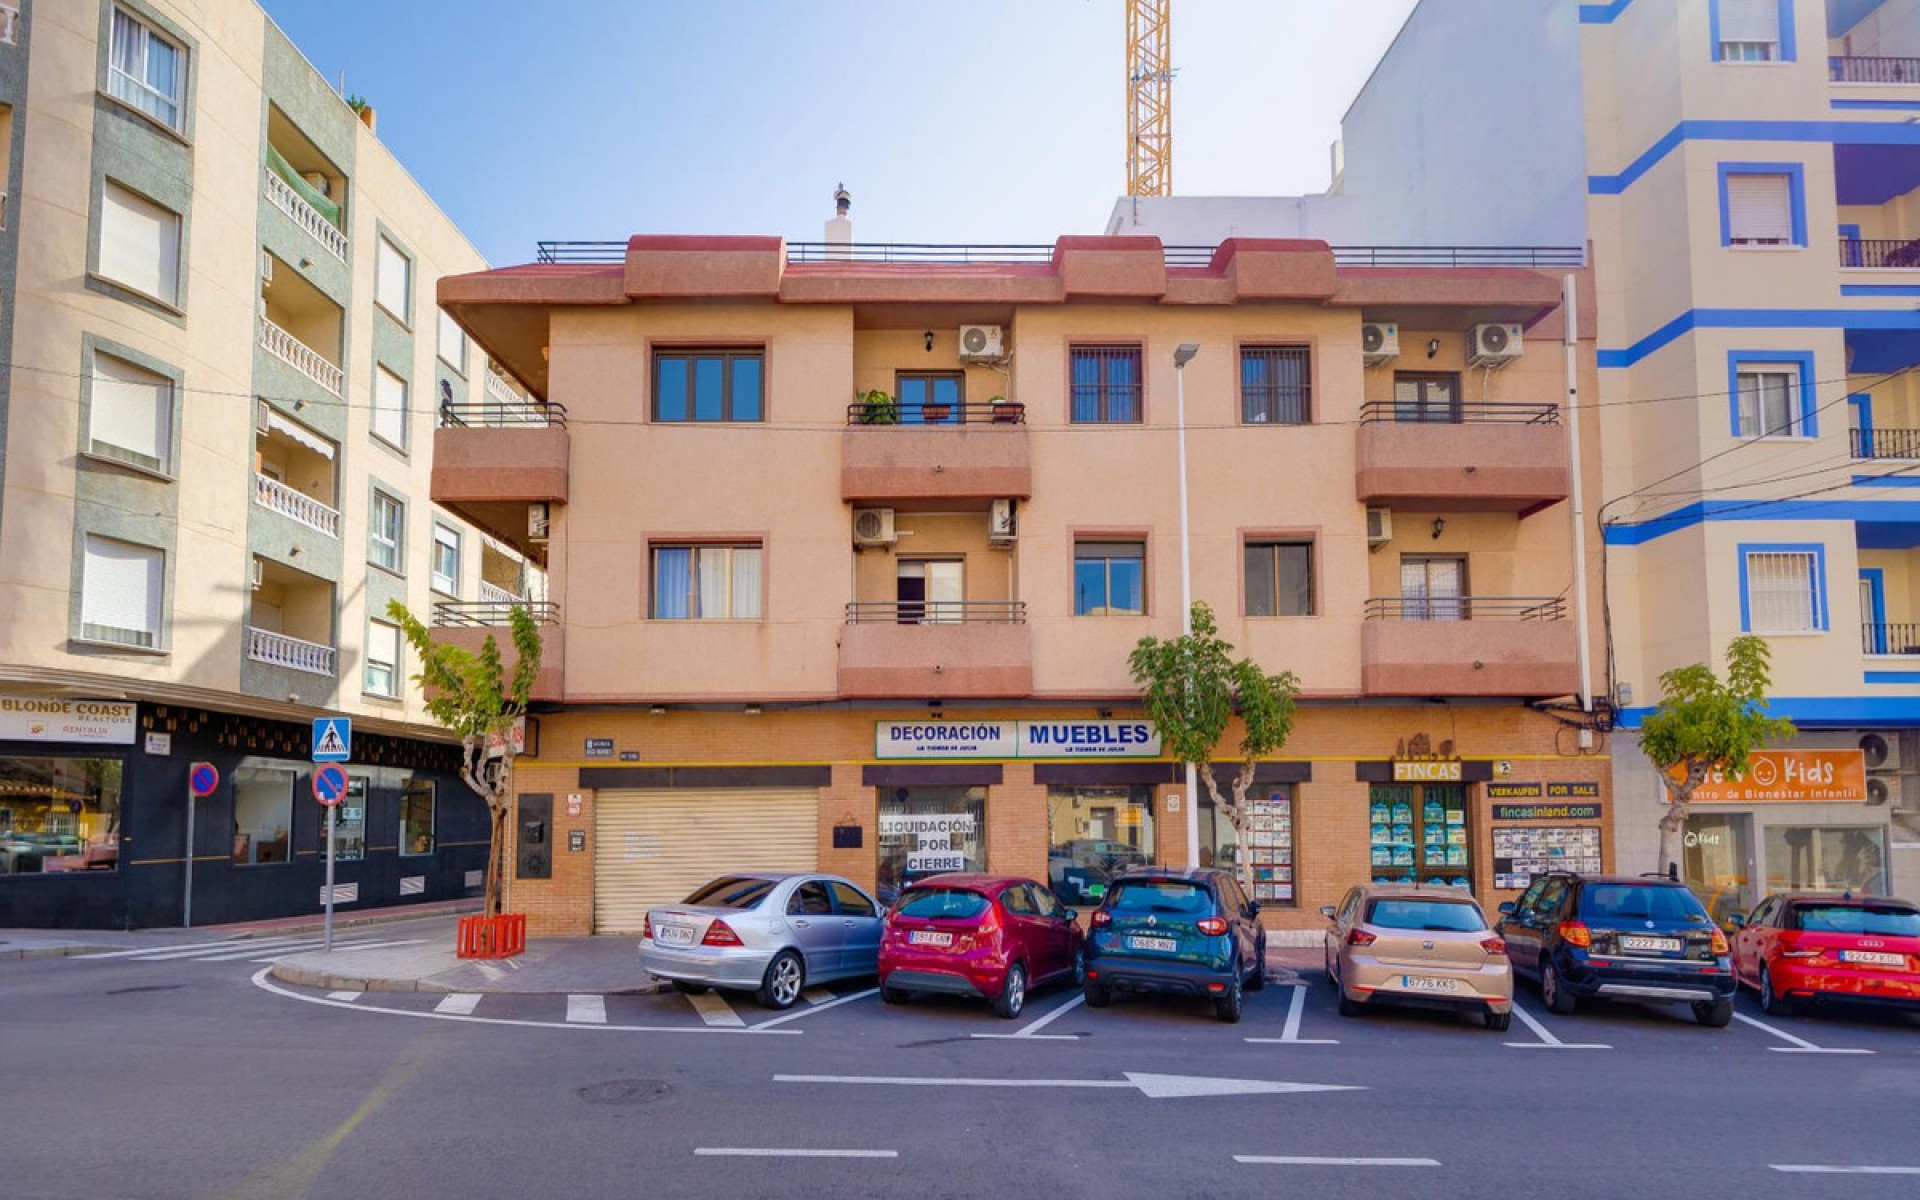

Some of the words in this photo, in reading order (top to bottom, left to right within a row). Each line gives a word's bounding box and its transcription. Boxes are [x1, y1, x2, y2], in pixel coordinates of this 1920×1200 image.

[2, 699, 71, 713] BLONDE
[76, 704, 132, 716] COAST
[78, 715, 132, 724] REALTORS
[890, 723, 1000, 740] DECORACIÓN
[1029, 724, 1149, 744] MUEBLES
[1395, 762, 1460, 780] FINCAS
[1783, 756, 1833, 784] Kids
[1549, 785, 1568, 795] FOR
[1572, 785, 1596, 795] SALE
[1745, 789, 1806, 799] Bienestar
[1810, 788, 1857, 798] Infantil
[881, 820, 973, 833] LIQUIDACIÓN
[919, 839, 949, 851] POR
[908, 858, 961, 869] CIERRE
[1409, 978, 1434, 988] 6776
